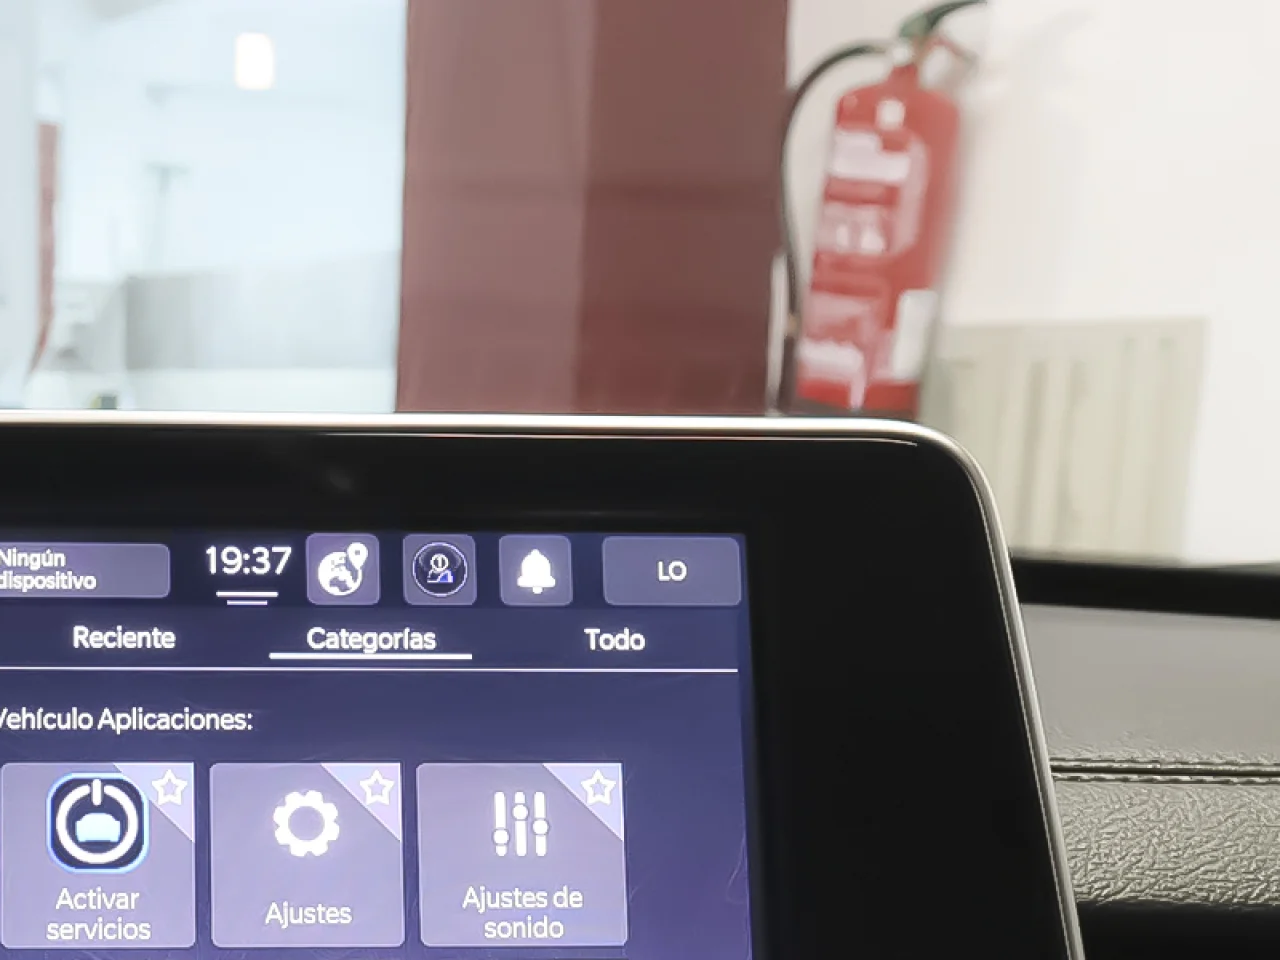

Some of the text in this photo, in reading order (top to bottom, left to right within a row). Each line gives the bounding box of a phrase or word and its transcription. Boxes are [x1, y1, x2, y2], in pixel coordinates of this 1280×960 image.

[206, 546, 291, 575] 19:37
[657, 561, 687, 581] LO
[72, 626, 176, 649] Reciente
[307, 626, 436, 653] Categorías
[584, 628, 646, 651] Todo
[98, 708, 253, 734] Aplicaciones:
[55, 887, 139, 910] Activar
[462, 886, 583, 911] Ajustes de
[265, 902, 352, 928] Ajustes
[46, 918, 151, 942] servicios
[484, 916, 564, 939] sonido
